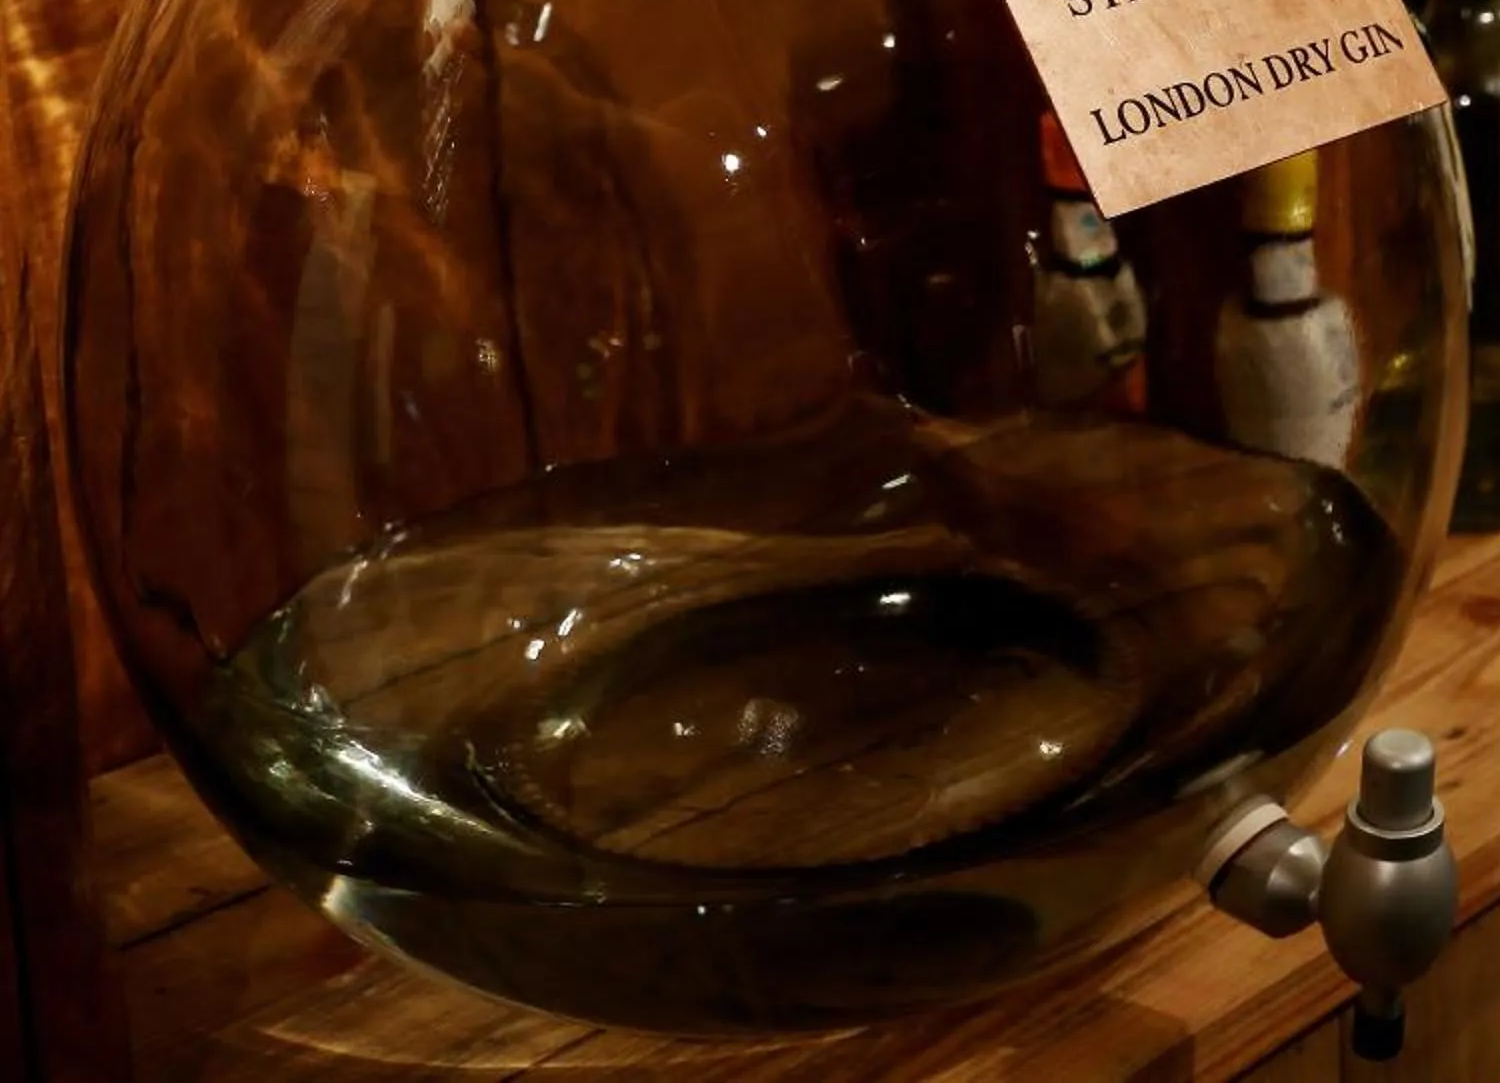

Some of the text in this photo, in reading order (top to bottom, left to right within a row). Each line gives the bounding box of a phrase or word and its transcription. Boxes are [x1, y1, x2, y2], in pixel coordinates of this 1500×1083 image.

[1090, 22, 1405, 146] LONDON DRY GIN
